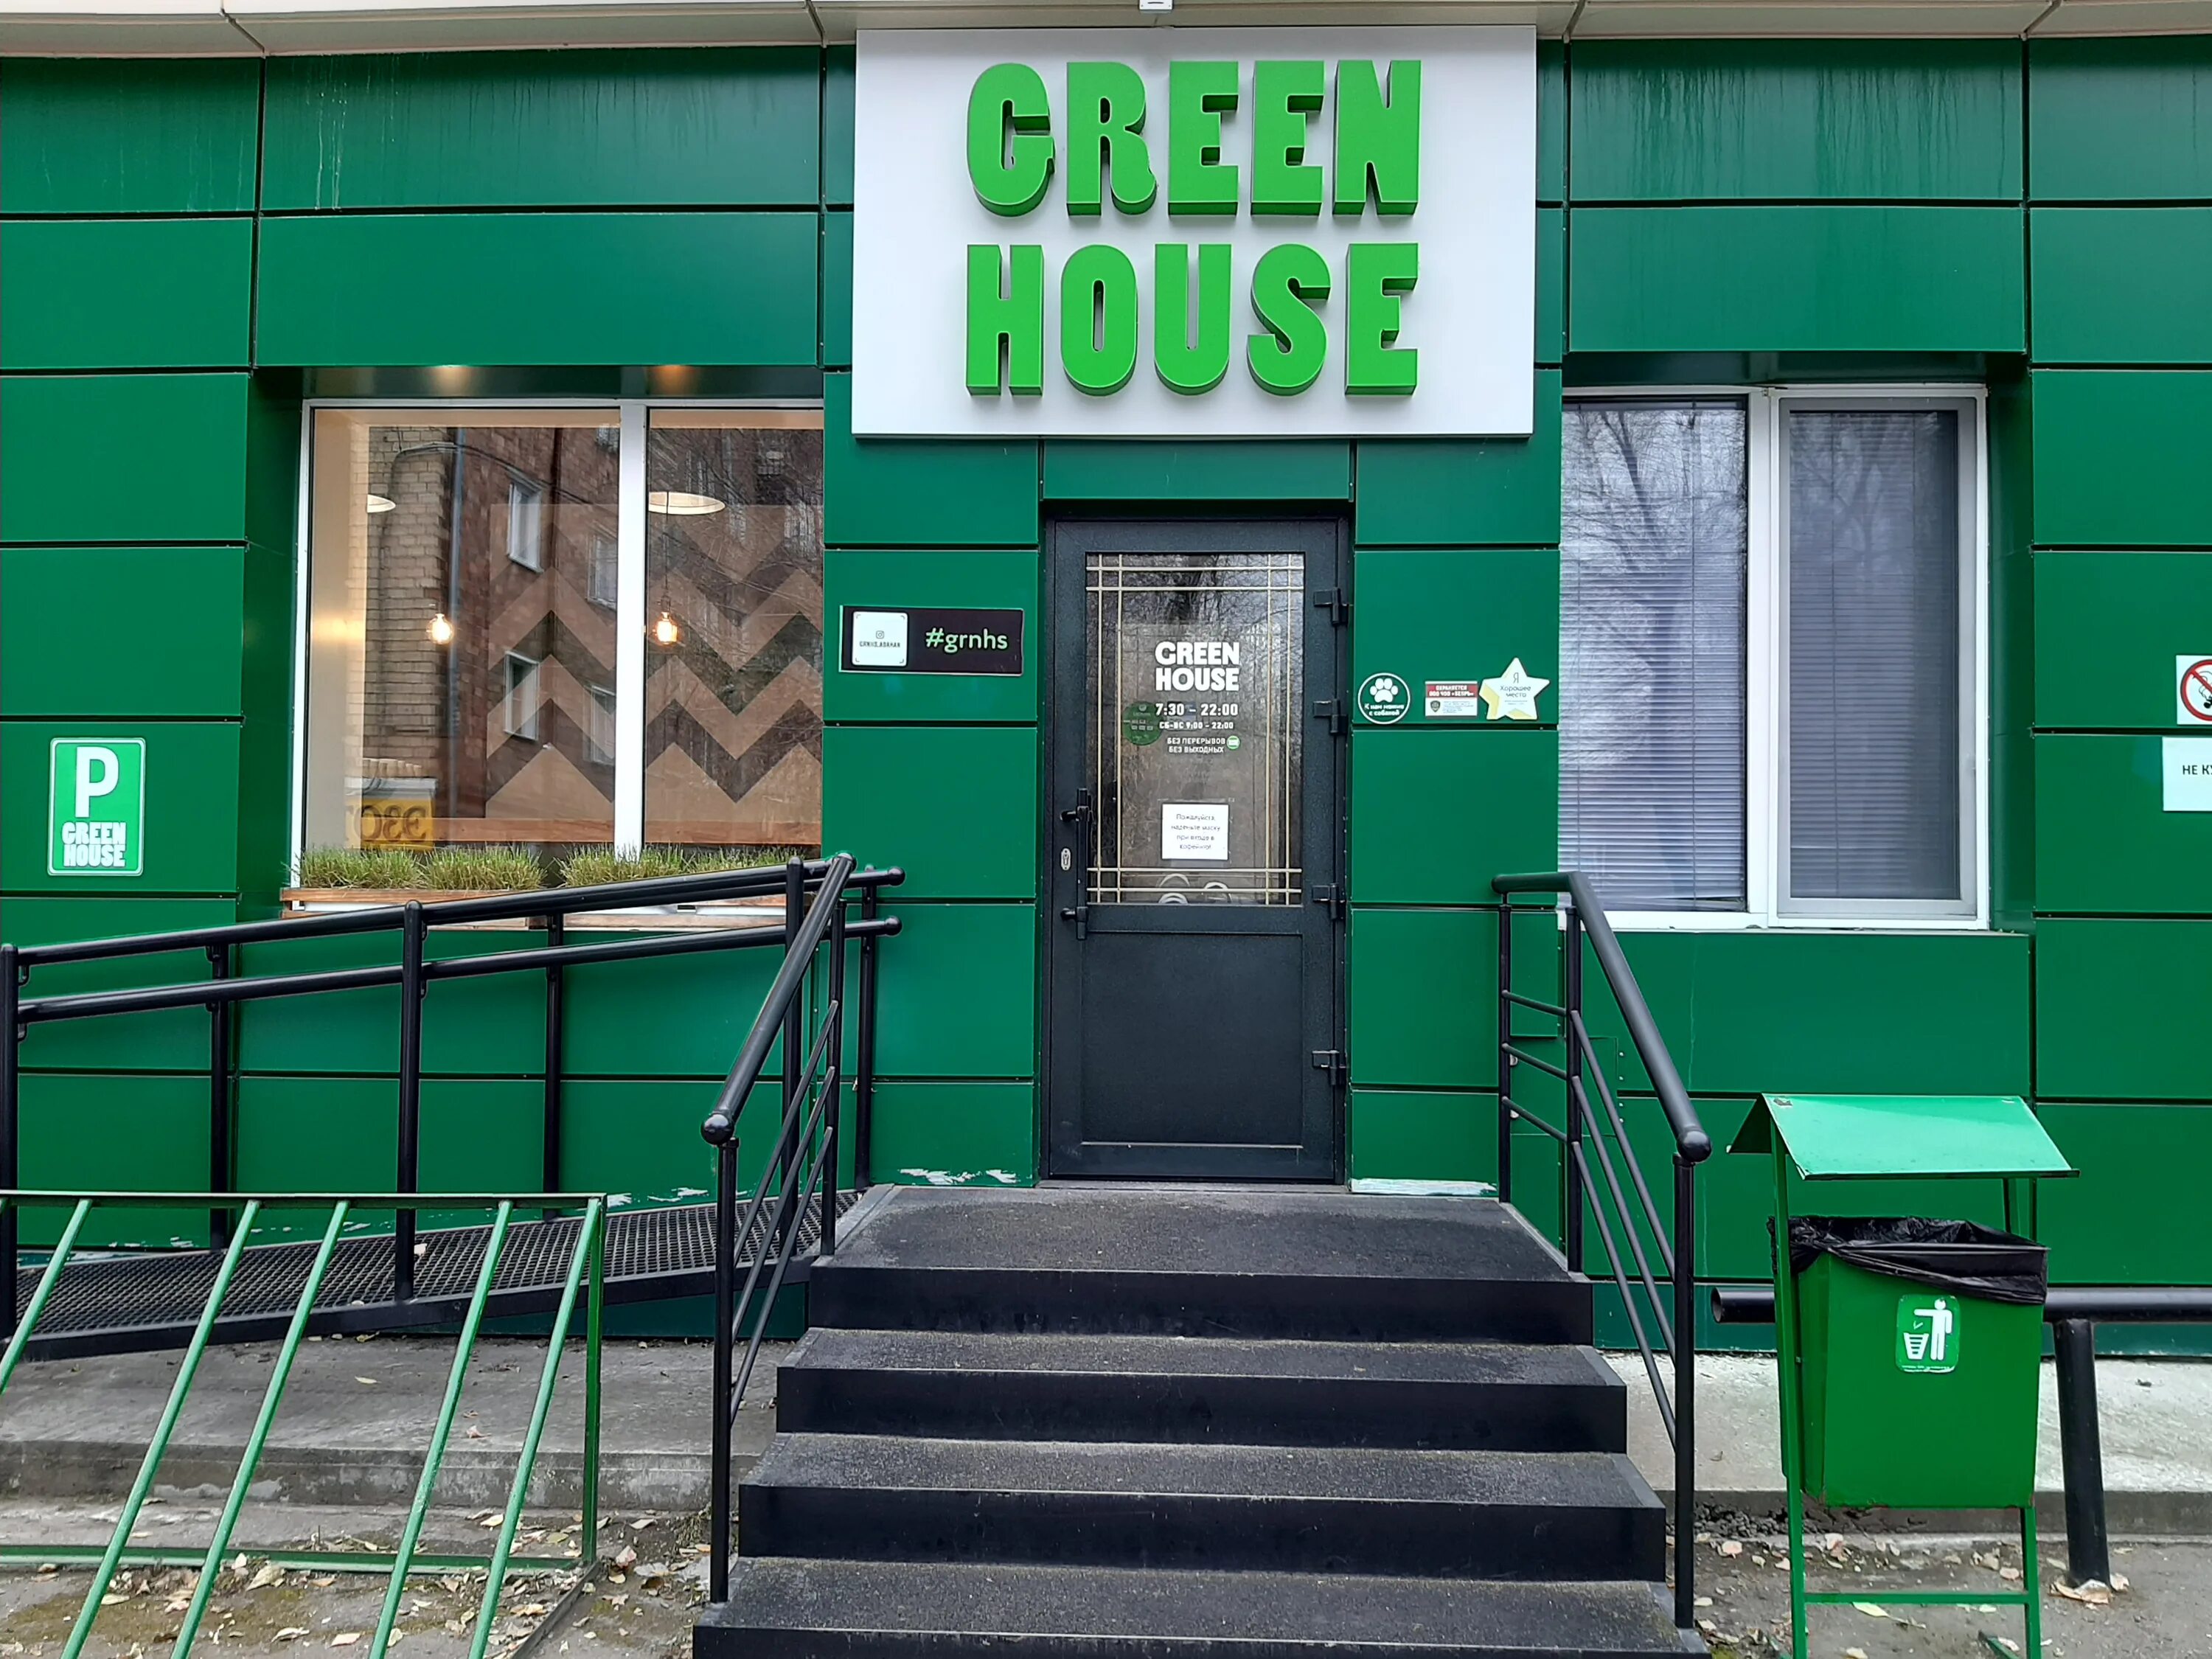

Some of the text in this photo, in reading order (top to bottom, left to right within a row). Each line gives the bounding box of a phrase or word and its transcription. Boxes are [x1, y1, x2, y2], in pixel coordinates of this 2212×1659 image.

[966, 59, 1422, 217] GREEN
[965, 242, 1419, 397] HOUSE
[925, 627, 1008, 654] #grnhs
[1154, 641, 1240, 666] GREEN
[1155, 667, 1240, 692] HOUSE
[1513, 672, 1519, 684] Я
[1155, 703, 1186, 717] 7:30
[1200, 703, 1239, 717] 22:00
[1182, 737, 1226, 745] ПЕРЕРЫВОВ
[1183, 746, 1225, 754] ВЫХОДНЫХ
[75, 746, 119, 818] P
[2183, 765, 2198, 775] НЕ
[62, 821, 127, 845] GREEN
[63, 844, 126, 867] HOUSE
